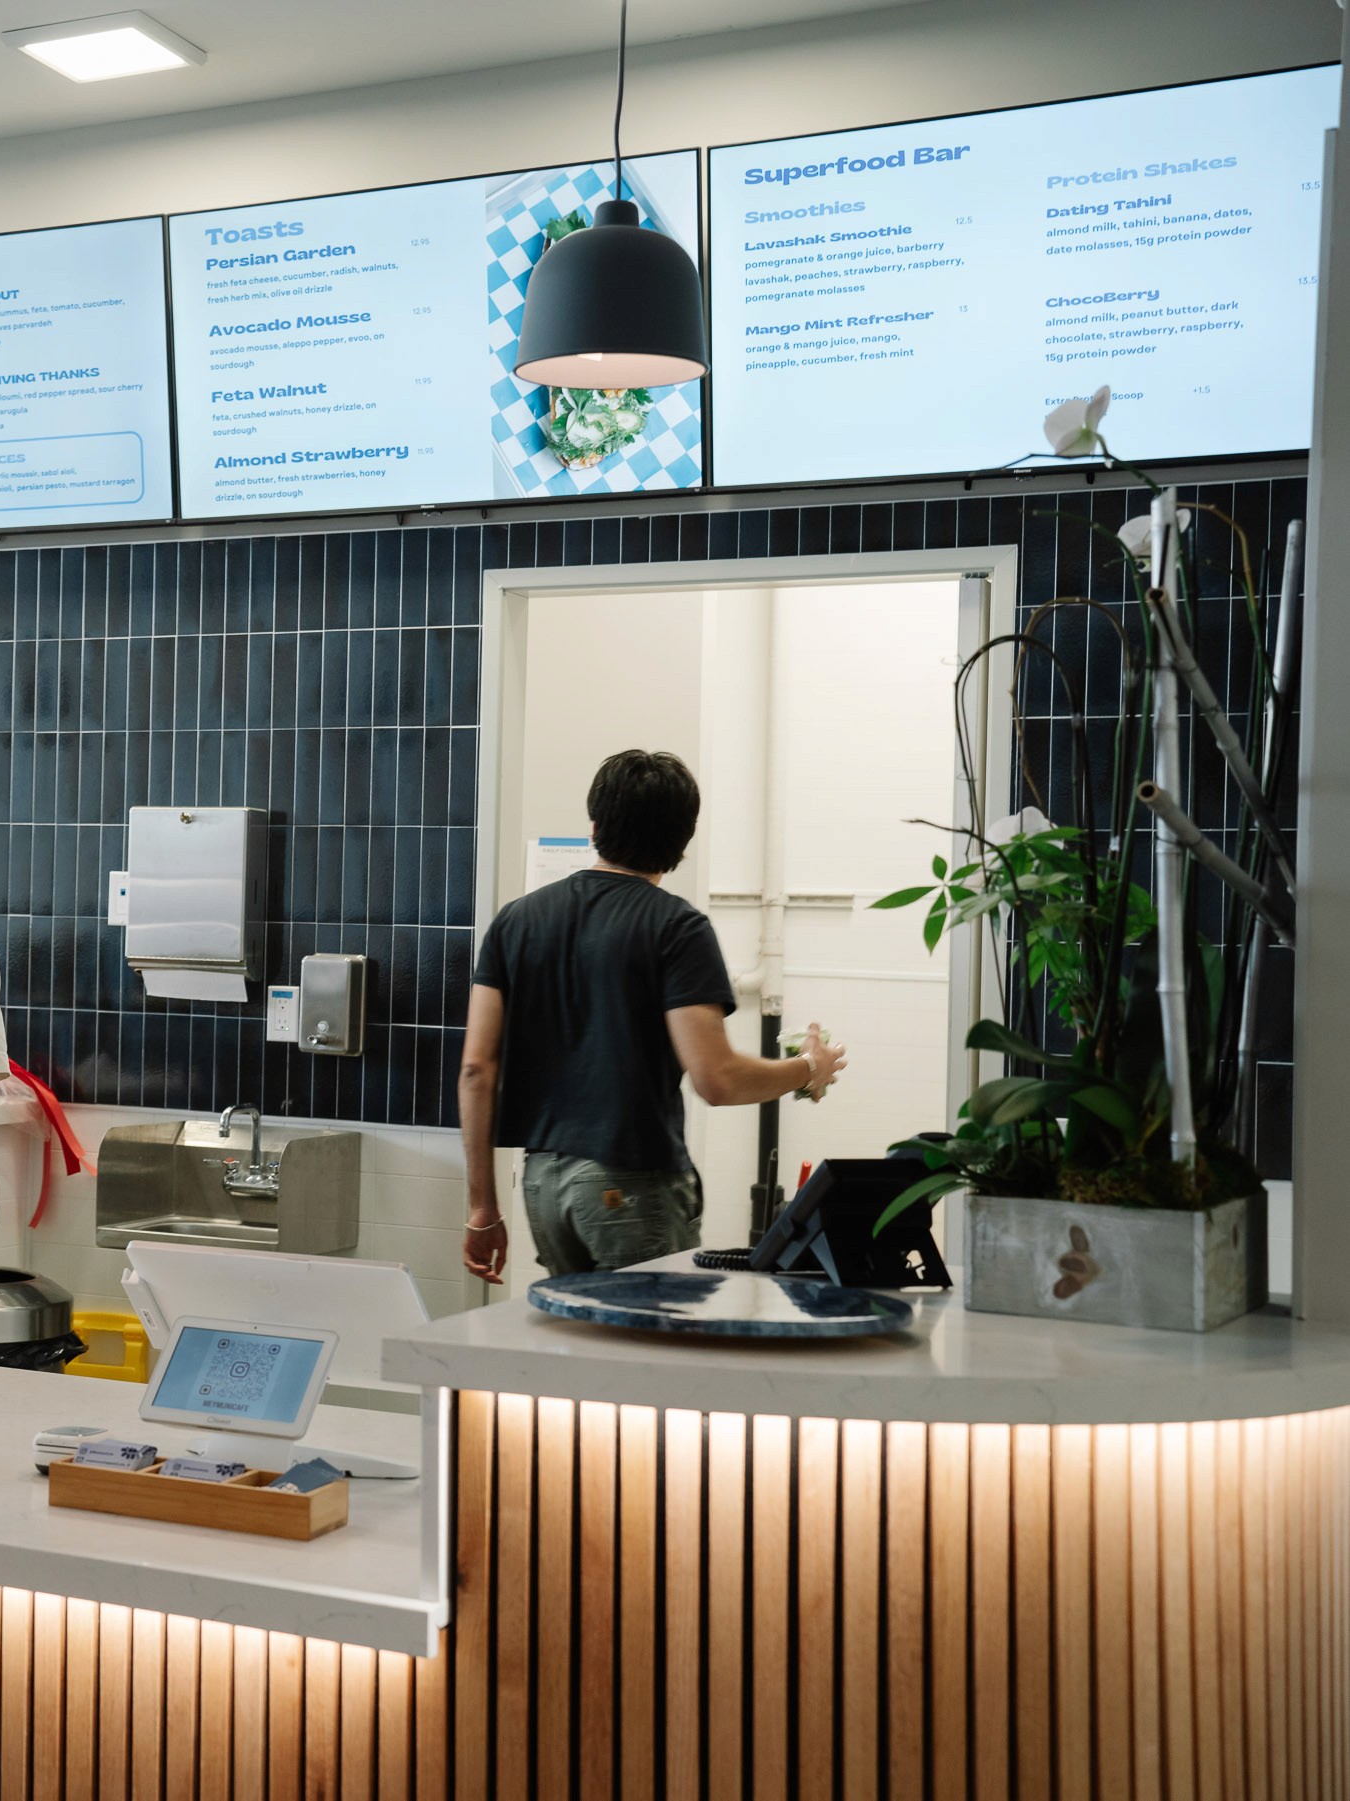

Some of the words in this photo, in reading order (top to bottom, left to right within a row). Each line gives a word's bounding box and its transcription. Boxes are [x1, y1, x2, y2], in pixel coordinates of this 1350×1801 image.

[744, 149, 905, 186] Superfood
[913, 145, 970, 165] Bar
[1046, 167, 1138, 189] Protein
[1144, 156, 1237, 177] Shakes
[1301, 181, 1320, 190] 13.5
[744, 200, 866, 224] Smoothies
[1046, 203, 1109, 218] Dating
[1113, 193, 1171, 211] Tahini
[955, 215, 972, 225] 12.5
[1046, 224, 1089, 237] almond
[1092, 221, 1120, 232] milk,
[1122, 216, 1160, 229] tahini,
[1163, 213, 1211, 224] banana,
[1213, 208, 1252, 219] dates,
[204, 220, 304, 246] Toasts
[744, 234, 826, 251] Lavashak
[829, 224, 912, 242] Smoothie
[1046, 245, 1072, 255] date
[1075, 240, 1132, 252] molasses,
[1135, 236, 1154, 247] 15g
[1157, 230, 1201, 245] protein
[1204, 225, 1252, 240] powder
[206, 253, 278, 271] Persian
[283, 245, 356, 262] Garden
[745, 255, 814, 271] pomegranate
[816, 253, 823, 262] &
[826, 251, 863, 261] orange
[865, 246, 894, 259] juice,
[896, 242, 944, 253] barberry
[206, 280, 228, 289] fresh
[229, 279, 247, 287] feta
[248, 276, 281, 285] cheese,
[282, 270, 329, 281] cucumber,
[330, 266, 360, 276] radish,
[361, 262, 398, 272] walnuts,
[745, 274, 792, 286] lavashak,
[794, 269, 841, 283] peaches,
[843, 264, 905, 276] strawberry,
[908, 258, 964, 269] raspberry,
[1298, 276, 1317, 285] 13.5
[207, 295, 229, 304] fresh
[230, 292, 250, 302] herb
[251, 290, 269, 299] mix,
[270, 288, 291, 298] olive
[292, 286, 303, 295] oil
[304, 284, 333, 294] drizzle
[745, 289, 814, 304] pomegranate
[816, 285, 865, 295] molasses
[1045, 289, 1159, 308] ChocoBerry
[959, 304, 968, 313] 13
[1045, 314, 1088, 327] almond
[1091, 312, 1118, 323] milk,
[1121, 308, 1163, 322] peanut
[1166, 305, 1208, 316] butter,
[1210, 300, 1238, 311] dark
[209, 318, 291, 337] Avocado
[296, 312, 371, 329] Mousse
[745, 323, 801, 336] Mango
[804, 318, 843, 331] Mint
[847, 311, 934, 327] Refresher
[1045, 332, 1106, 344] chocolate,
[1108, 326, 1178, 339] strawberry,
[1180, 320, 1243, 333] raspberry,
[209, 345, 245, 356] avocado
[246, 343, 281, 352] mousse,
[282, 340, 311, 349] aleppo
[313, 337, 346, 347] pepper,
[347, 334, 372, 342] evoo,
[745, 344, 781, 353] orange
[783, 341, 790, 350] &
[793, 340, 828, 349] mango
[830, 336, 858, 348] juice,
[861, 334, 900, 343] mango,
[1045, 353, 1063, 363] 15g
[1066, 348, 1108, 362] protein
[1111, 344, 1156, 358] powder
[209, 359, 254, 371] sourdough
[745, 358, 799, 372] pineapple,
[801, 354, 857, 366] cucumber,
[859, 350, 887, 360] fresh
[889, 348, 914, 358] mint
[39, 367, 100, 381] THANKS
[211, 390, 254, 403] Feta
[258, 382, 327, 399] Walnut
[1112, 392, 1144, 400] Scoop
[1193, 385, 1210, 394] +1.5
[212, 413, 231, 422] feta,
[232, 410, 267, 420] crushed
[268, 408, 304, 417] walnuts,
[305, 406, 332, 414] honey
[332, 402, 364, 412] drizzle,
[212, 425, 257, 437] sourdough
[214, 452, 286, 469] Almond
[291, 445, 409, 463] Strawberry
[214, 477, 246, 487] almond
[247, 477, 276, 485] butter,
[277, 474, 299, 482] fresh
[301, 470, 358, 481] strawberries,
[359, 469, 386, 477] honey
[215, 493, 245, 502] drizzle,
[258, 488, 303, 499] sourdough
